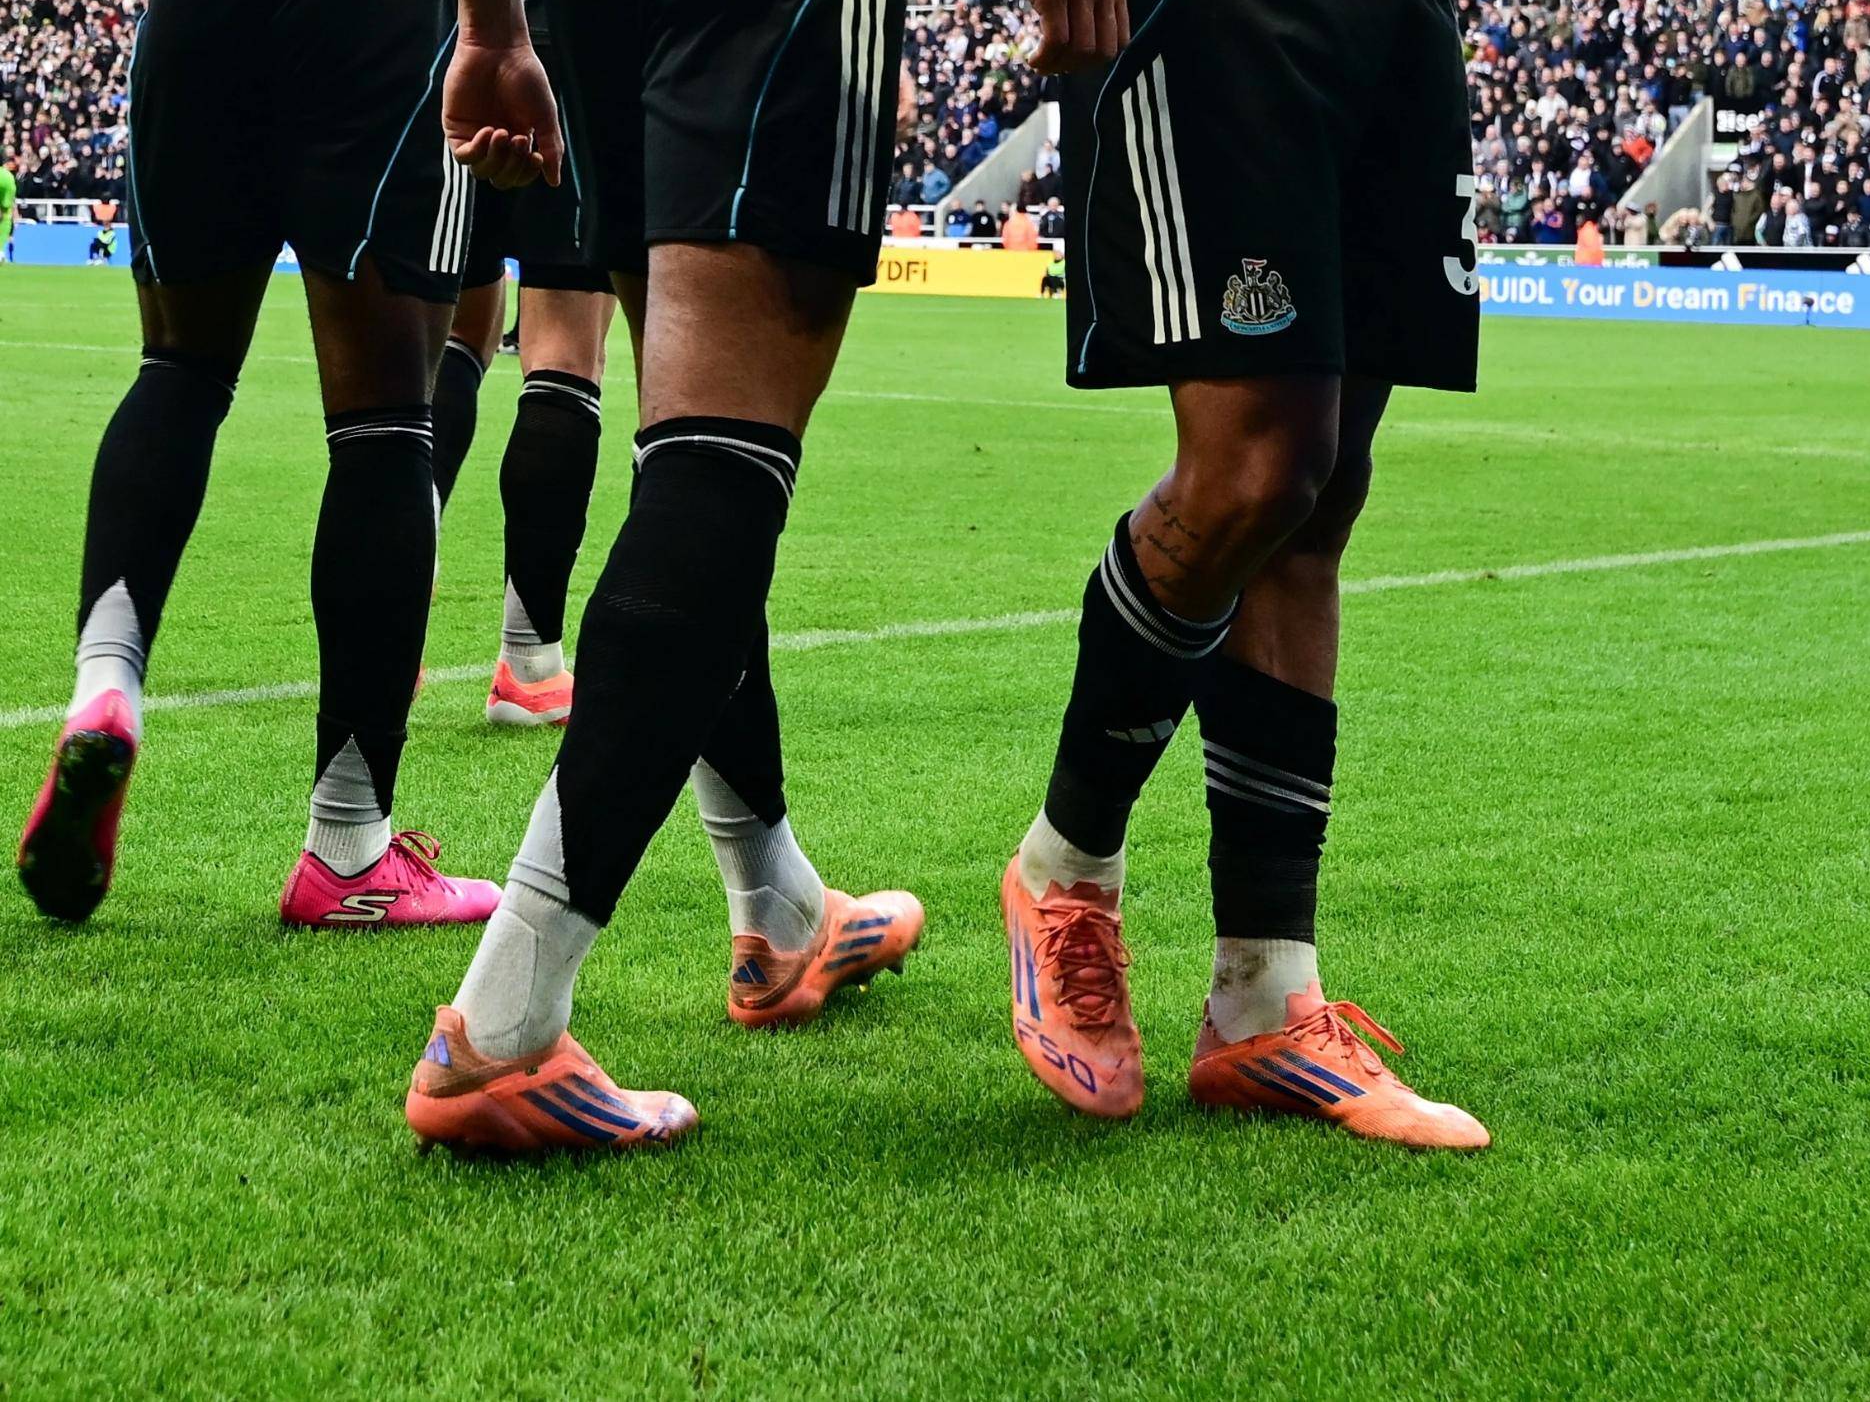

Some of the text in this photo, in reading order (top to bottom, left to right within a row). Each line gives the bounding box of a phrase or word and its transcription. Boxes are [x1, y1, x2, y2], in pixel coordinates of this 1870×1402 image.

[1561, 277, 1627, 307] Your
[1632, 280, 1730, 311] Dream
[1737, 282, 1855, 315] Finance
[1016, 1018, 1098, 1094] F50
